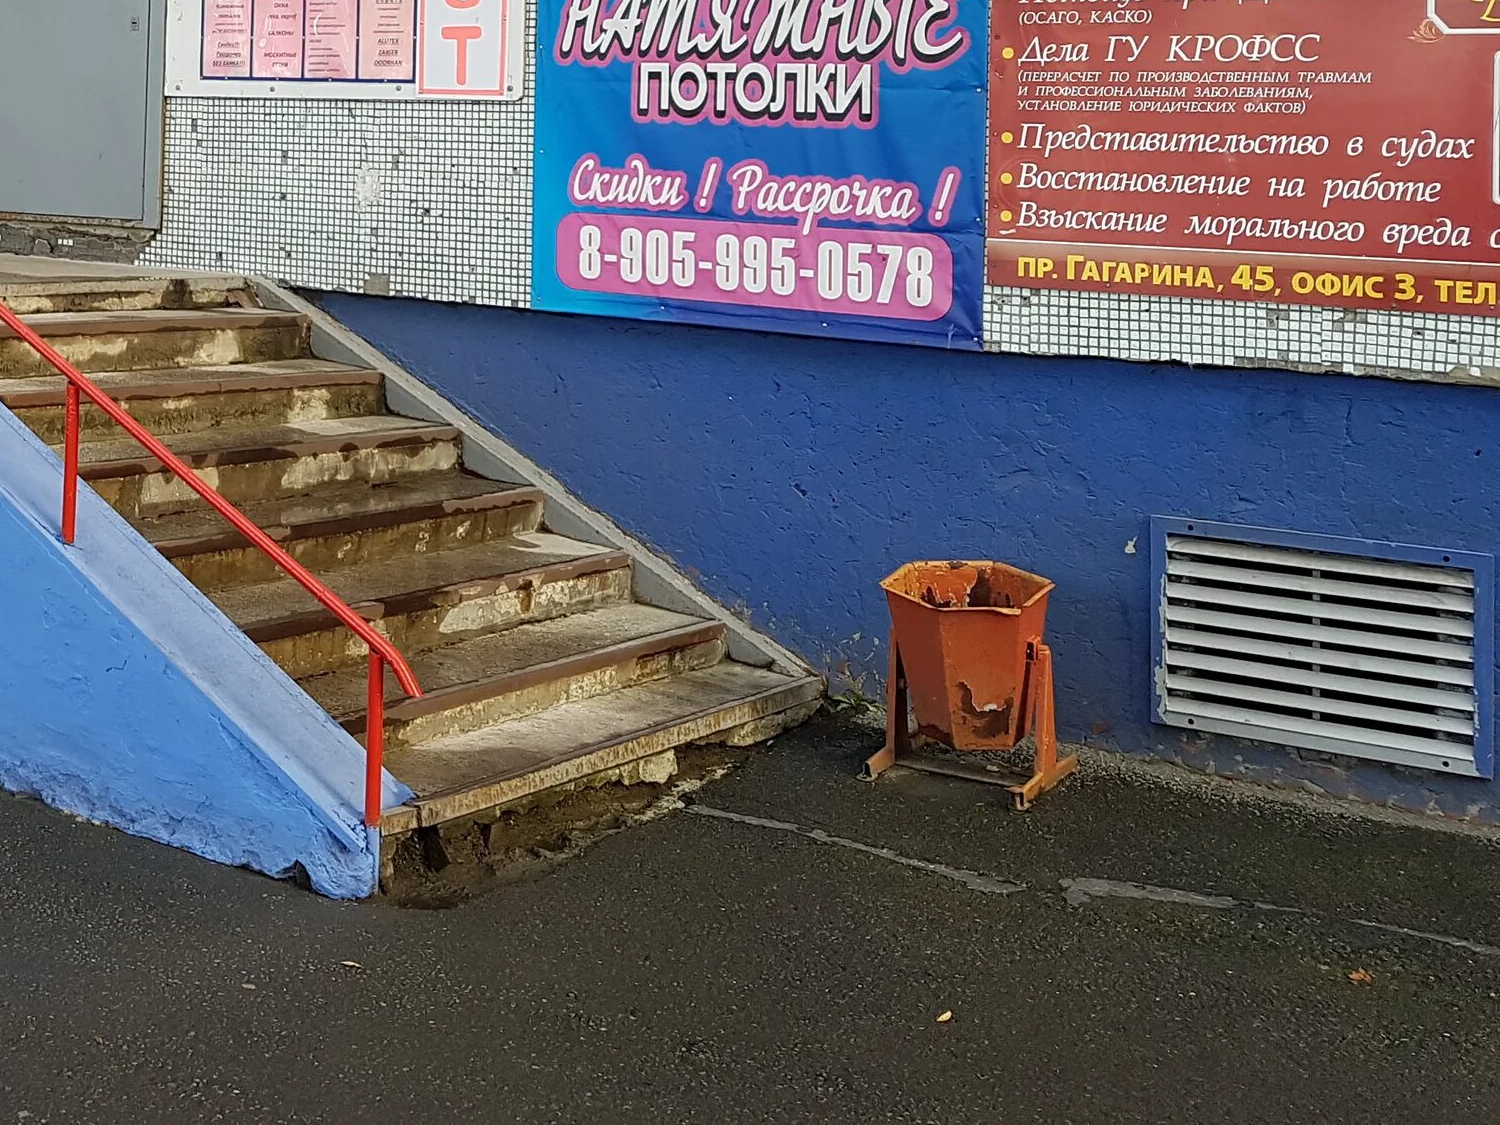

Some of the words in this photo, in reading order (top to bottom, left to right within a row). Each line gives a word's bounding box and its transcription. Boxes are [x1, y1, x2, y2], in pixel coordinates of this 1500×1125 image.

[1019, 9, 1084, 25] (ОСАГО,
[1090, 9, 1153, 24] КАСКО)
[1018, 37, 1090, 66] Дела
[1105, 36, 1147, 63] ГУ
[1166, 33, 1320, 63] КРОФСС
[637, 62, 872, 115] ПОТОЛКИ
[1017, 70, 1102, 84] (ПЕРЕРАСЧЕТ
[1109, 71, 1130, 82] ПО
[1136, 70, 1289, 84] ПРОИЗВОДСТВЕННЫМ
[1298, 71, 1372, 83] ТРАВМАМ
[1017, 86, 1028, 96] И
[1035, 86, 1186, 98] ПРОФЕССИОНАЛЬНЫМ
[1194, 86, 1313, 101] ЗАБОЛЕВАНИЯМ,
[1017, 101, 1121, 112] УСТАНОВЛЕНИЕ
[1128, 101, 1235, 114] ЮРИДИЧЕСКИХ
[1243, 101, 1307, 115] ФАКТОВ)
[1017, 124, 1329, 156] Представительство
[1346, 136, 1363, 154] в
[1381, 131, 1474, 166] судах
[572, 158, 684, 206] Скидки
[732, 164, 915, 236] Рассрочка
[1017, 165, 1250, 196] Восстановление
[1268, 176, 1305, 197] на
[1323, 173, 1441, 207] работе
[1017, 202, 1167, 233] Взыскание
[1184, 213, 1364, 244] морального
[1382, 220, 1471, 253] вреда
[578, 225, 933, 307] 8-905-995-0578
[1230, 265, 1281, 295] 45,
[1292, 272, 1385, 299] ОФИС
[1393, 276, 1423, 304] 3,
